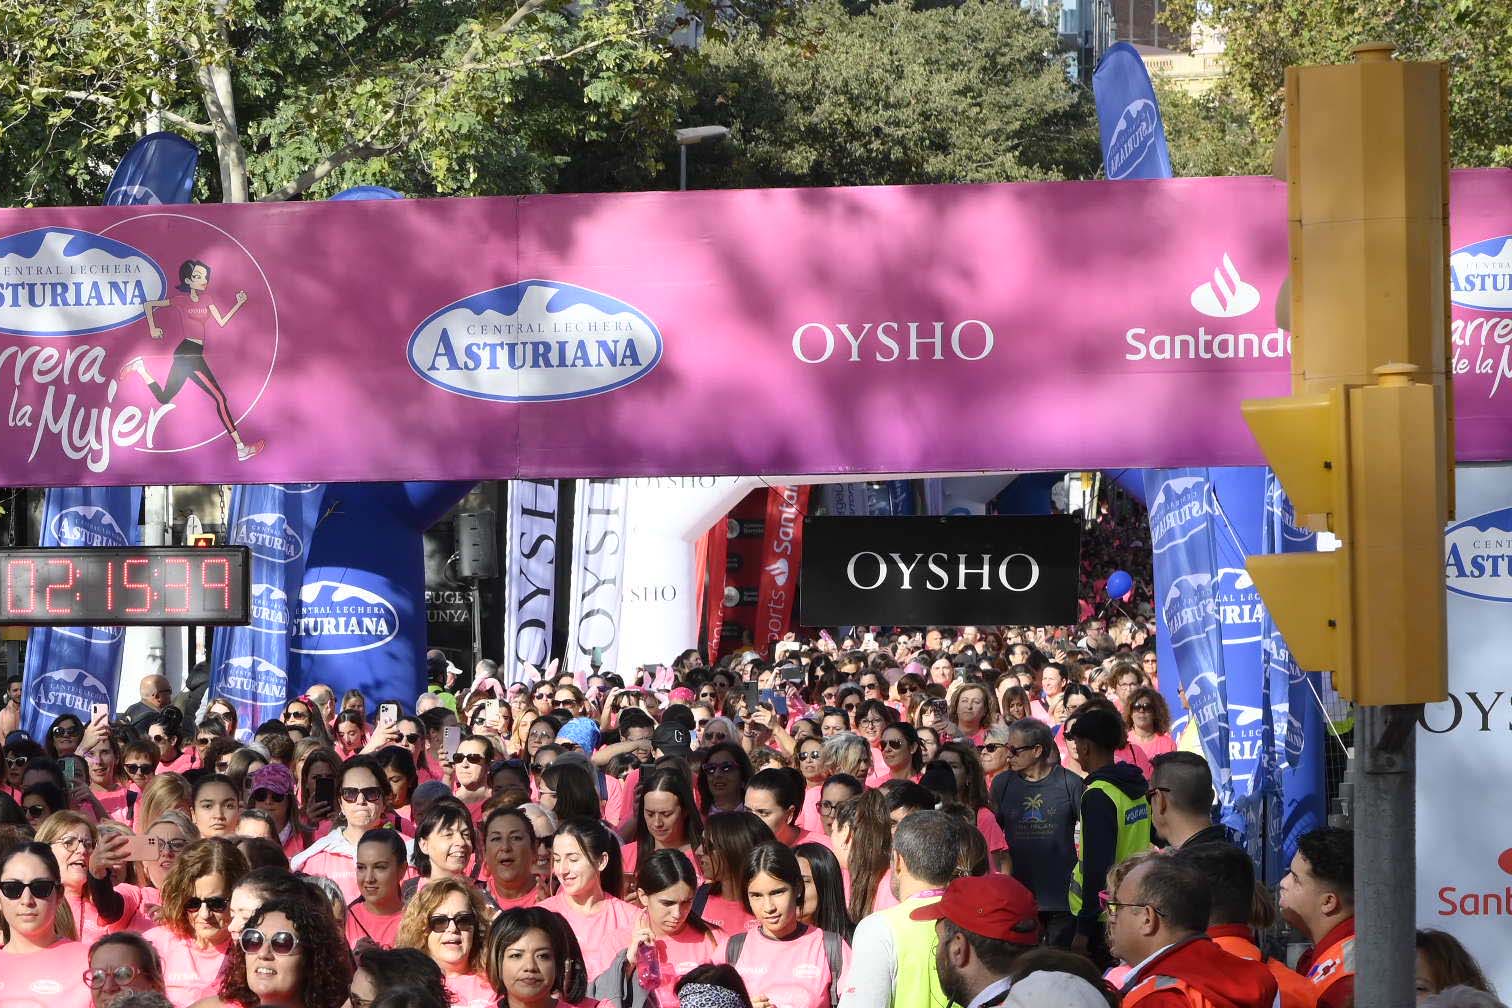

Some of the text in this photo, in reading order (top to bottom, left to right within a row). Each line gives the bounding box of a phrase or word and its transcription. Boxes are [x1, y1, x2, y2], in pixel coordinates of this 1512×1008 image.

[70, 264, 141, 275] LECHERA
[466, 320, 634, 335] CENTRAL LECHERA
[792, 320, 995, 364] OYSHO
[428, 328, 642, 373] ASTURIANA
[1475, 346, 1494, 374] la
[8, 387, 32, 427] la
[27, 380, 176, 472] Mujer
[6, 559, 231, 613] 02:15:39
[846, 550, 1041, 593] OYSHO
[335, 607, 386, 615] LECHERA
